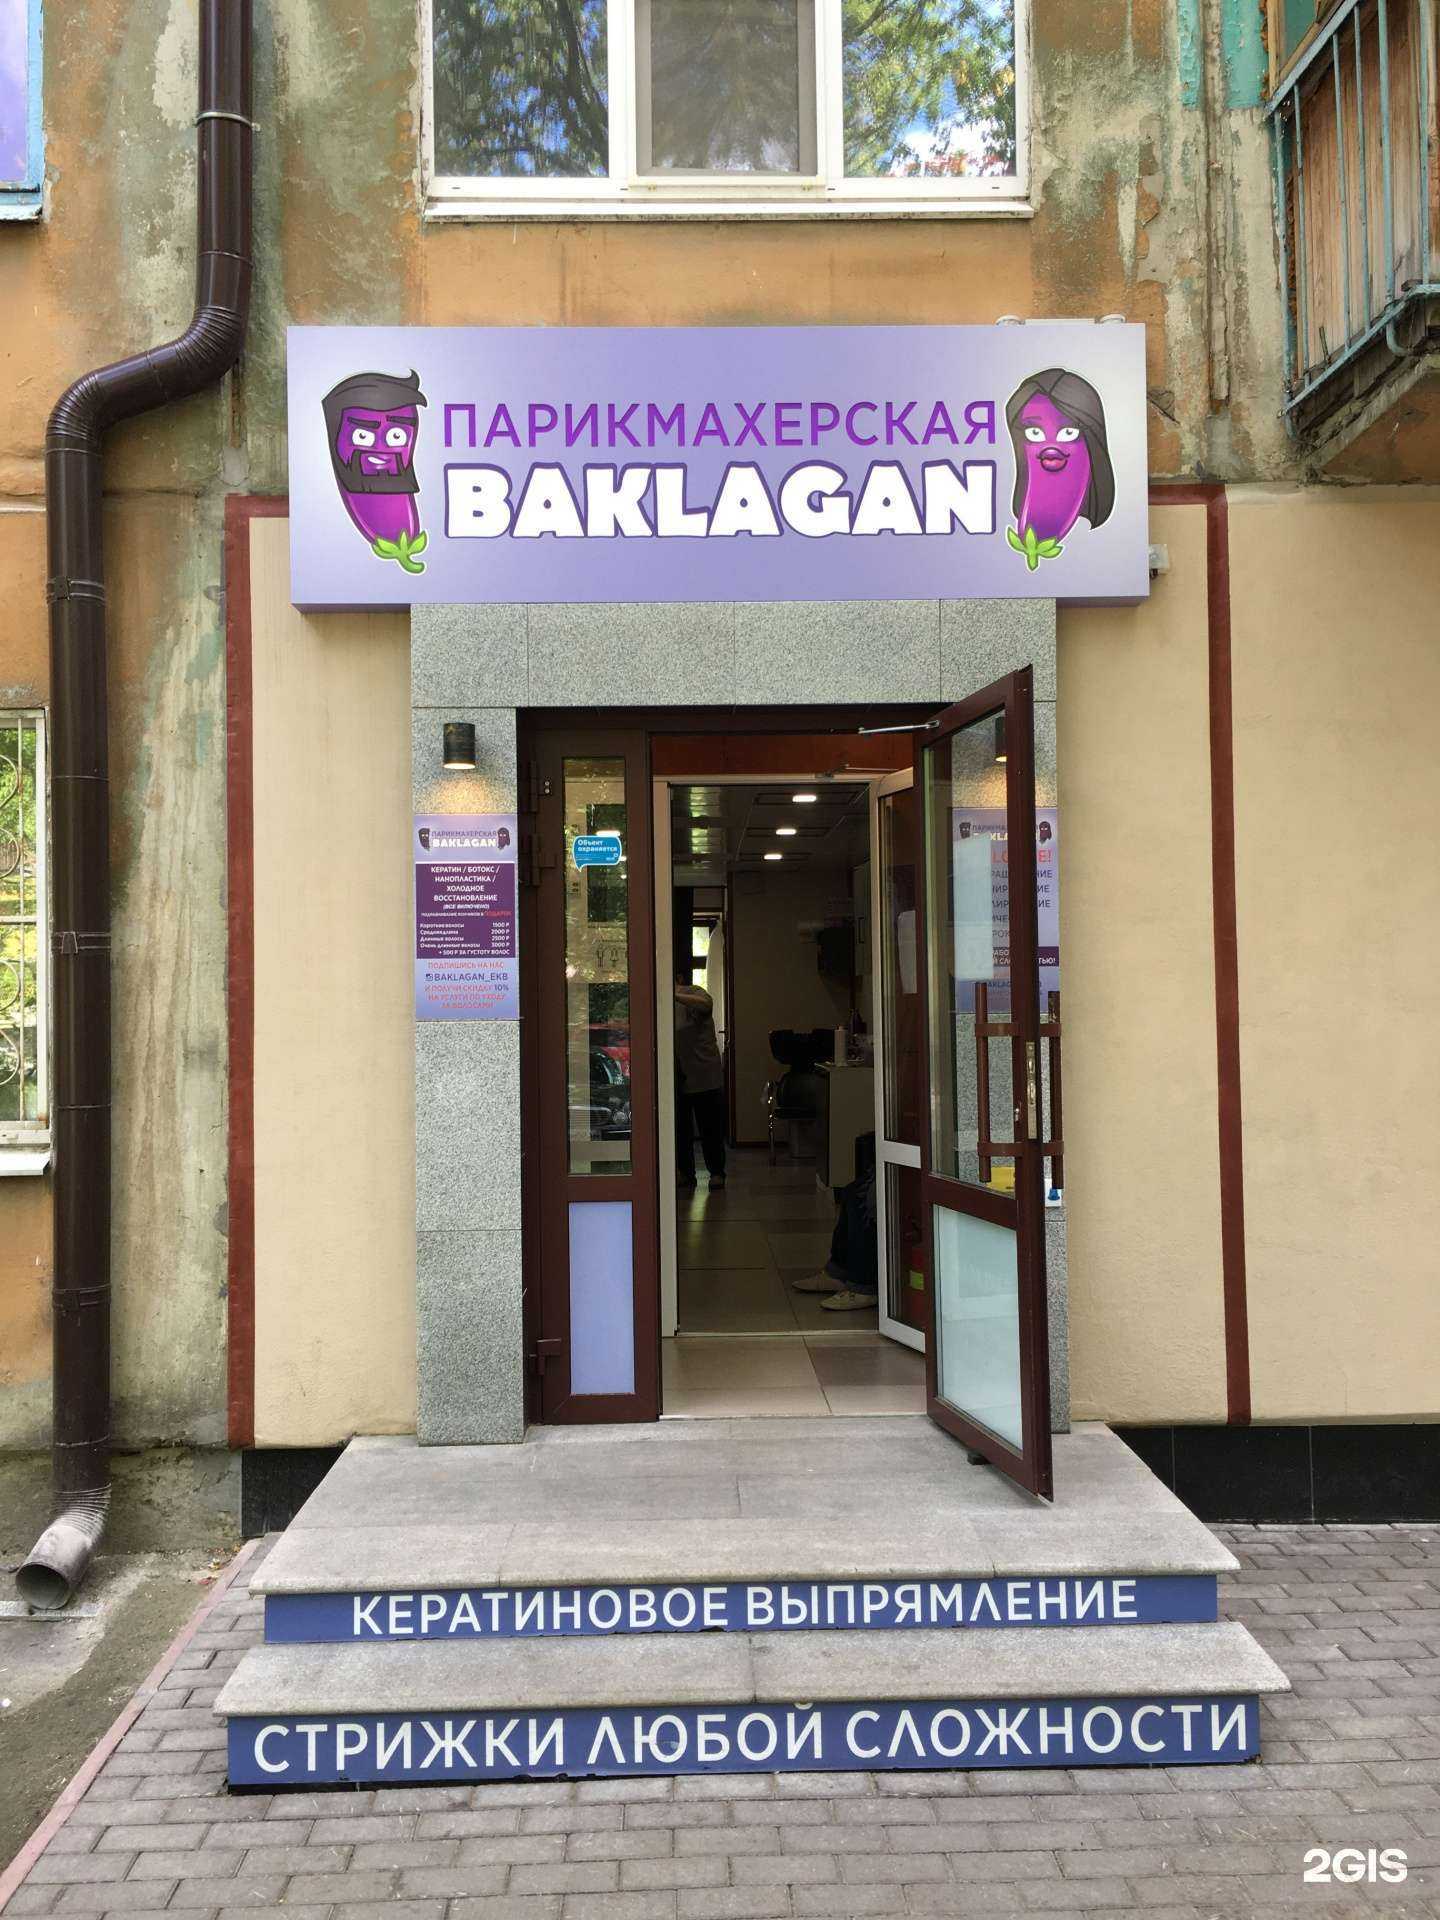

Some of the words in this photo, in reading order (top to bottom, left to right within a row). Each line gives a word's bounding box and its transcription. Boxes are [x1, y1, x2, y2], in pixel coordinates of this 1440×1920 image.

[443, 401, 997, 449] ПАРИКМАХЕРСКАЯ
[443, 459, 997, 539] BAKLAGAN
[432, 838, 496, 848] BAKLAGAN
[434, 972, 508, 982] BAKLAGAN_EKB
[352, 1586, 729, 1637] КЕРАТИНОВОЕ
[748, 1579, 1138, 1627] ВЫПРЯМЛЕНИЕ
[253, 1717, 563, 1775] СТРИЖКИ
[586, 1702, 823, 1765] ЛЮБОЙ
[845, 1703, 1248, 1760] СЛОЖНОСТИ
